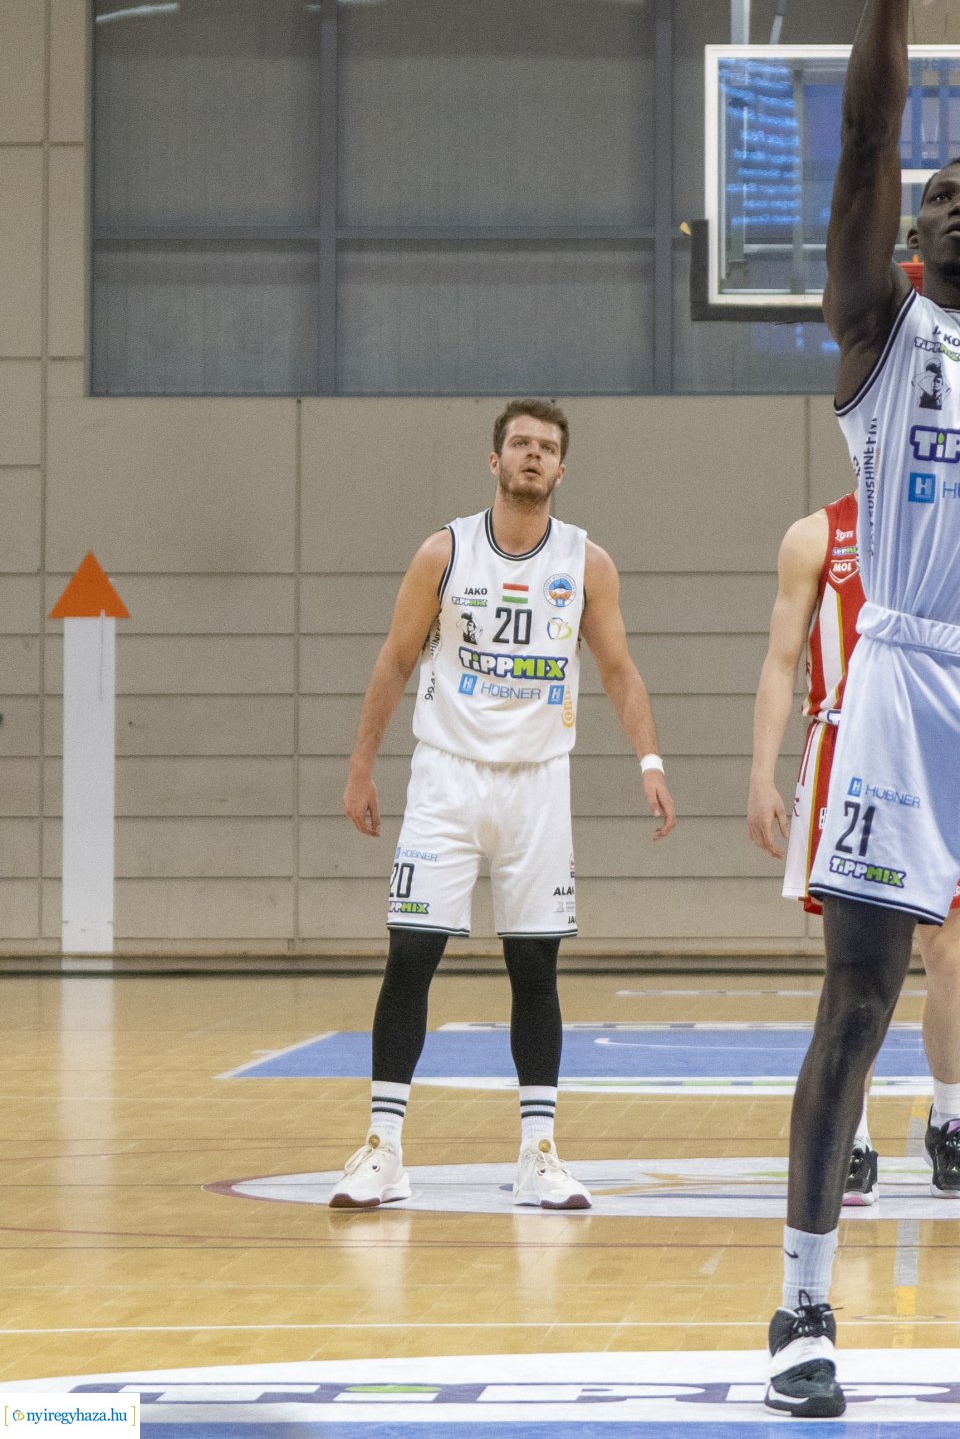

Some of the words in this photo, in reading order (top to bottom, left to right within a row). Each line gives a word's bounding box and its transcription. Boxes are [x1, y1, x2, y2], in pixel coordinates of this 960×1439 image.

[832, 562, 853, 572] MOL
[463, 586, 489, 596] JAKO
[492, 606, 533, 645] 20
[480, 681, 542, 701] HÜBNER
[835, 800, 876, 858] 21
